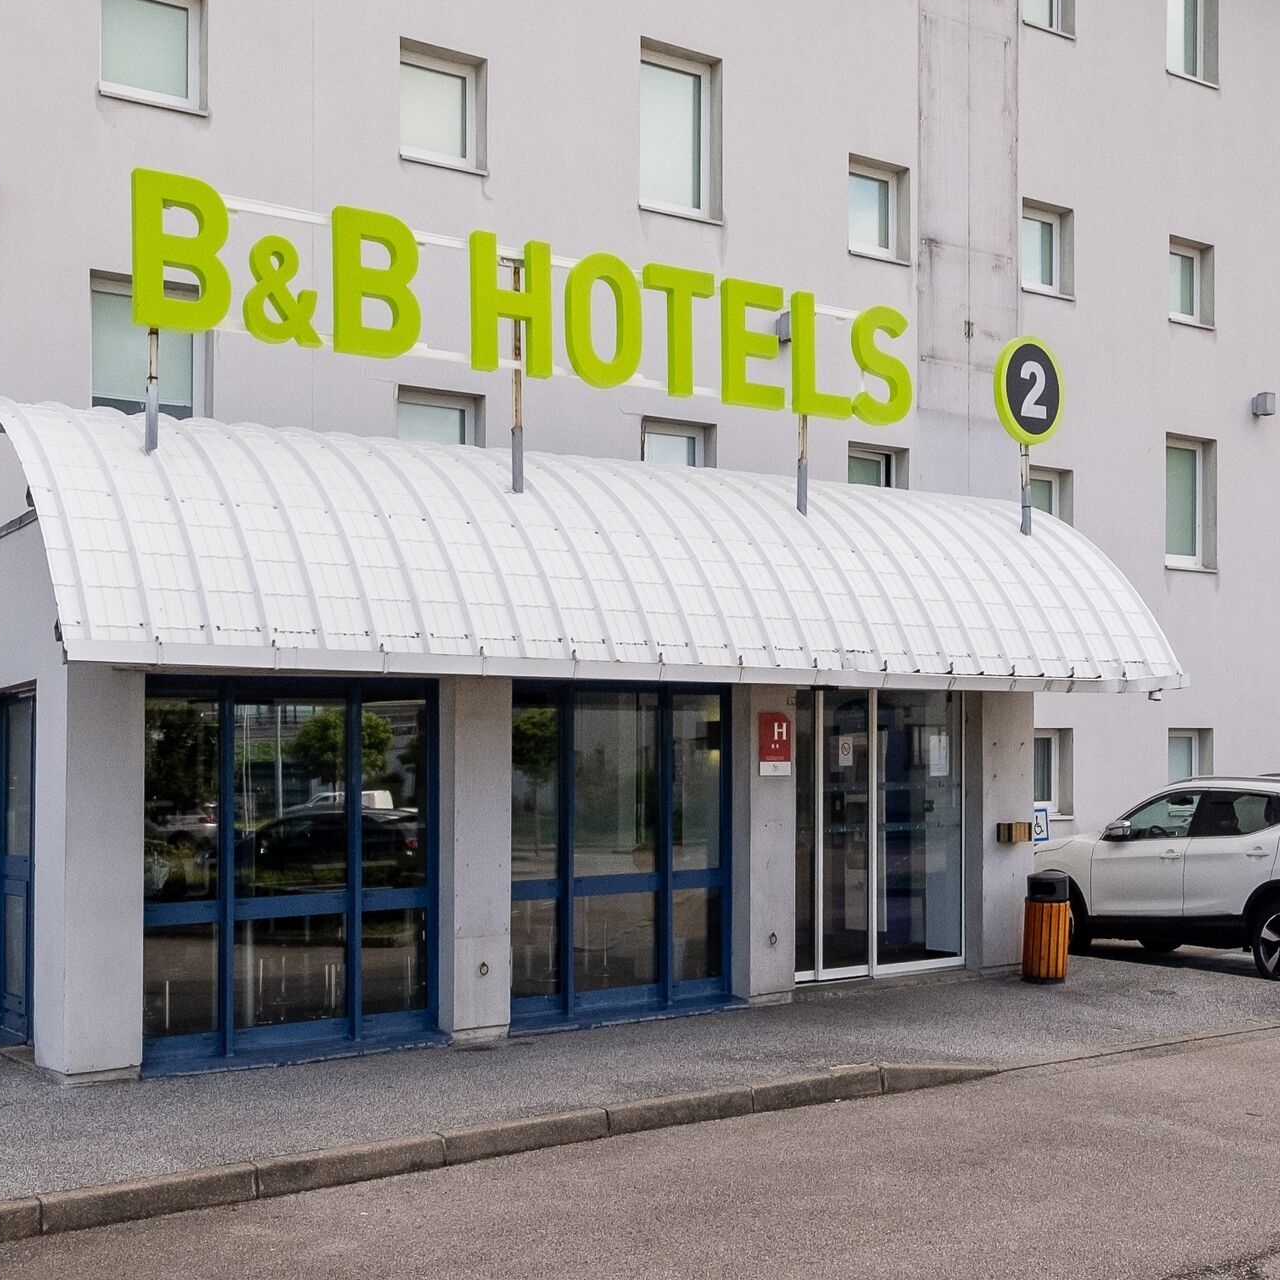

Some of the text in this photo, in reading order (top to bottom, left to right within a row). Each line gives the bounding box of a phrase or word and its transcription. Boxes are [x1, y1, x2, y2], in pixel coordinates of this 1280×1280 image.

[131, 167, 913, 426] B&B HOTELS
[1020, 360, 1047, 420] 2
[773, 722, 787, 740] H
